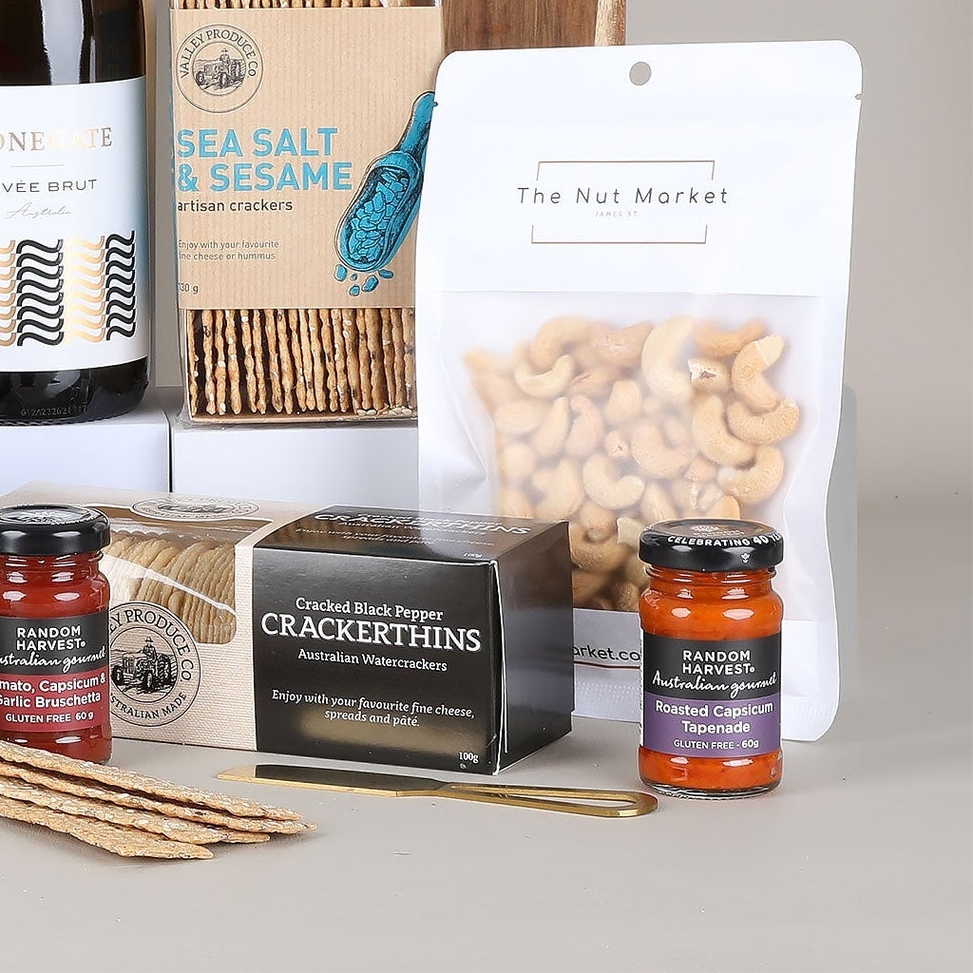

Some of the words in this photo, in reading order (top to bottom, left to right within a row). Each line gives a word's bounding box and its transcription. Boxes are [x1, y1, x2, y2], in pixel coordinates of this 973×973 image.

[179, 33, 206, 79] VALLEY
[205, 28, 257, 60] PRODUCE
[177, 128, 244, 158] SEA
[252, 127, 338, 157] SALT
[48, 179, 98, 192] BRUT
[178, 163, 200, 192] &
[209, 161, 353, 192] SESAME
[517, 186, 561, 204] The
[575, 186, 620, 204] Nut
[634, 186, 728, 204] Market
[177, 199, 225, 212] artisan
[229, 198, 293, 212] crackers
[178, 239, 198, 250] Enjoy
[200, 240, 219, 248] with
[220, 241, 239, 250] your
[242, 240, 279, 249] favourite
[193, 252, 224, 260] cheese
[237, 252, 276, 260] hummus
[667, 535, 751, 547] CELEBRATING
[752, 534, 770, 545] 40
[295, 597, 351, 614] Cracked
[354, 600, 392, 618] Black
[394, 604, 444, 622] Pepper
[17, 626, 82, 639] RANDOM
[124, 608, 190, 656] PRODUCE
[260, 612, 482, 653] CRACKERTHINS
[62, 645, 107, 673] gourmet
[297, 648, 360, 665] Australian
[362, 654, 448, 672] Watercrackers
[572, 644, 641, 661] arket.co
[683, 649, 751, 662] RANDOM
[39, 677, 99, 694] Capsicum
[99, 673, 106, 684] &
[652, 669, 730, 691] Australian
[730, 671, 778, 699] gourmet
[35, 691, 101, 709] Bruschetta
[110, 692, 160, 719] STRALIAN
[161, 692, 188, 717] MADE
[271, 689, 303, 705] Enjoy
[304, 693, 329, 706] with
[330, 697, 357, 709] your
[357, 696, 410, 713] favourite
[410, 702, 434, 714] fine
[435, 704, 476, 719] cheese,
[655, 700, 709, 718] Roasted
[713, 701, 774, 718] Capsicum
[5, 713, 44, 724] GLUTEN
[46, 713, 72, 724] FREE
[324, 710, 367, 724] spreads
[369, 712, 391, 725] and
[392, 713, 420, 728] pâté.
[681, 719, 751, 736] Tapenade
[673, 739, 709, 750] GLUTEN
[711, 739, 735, 750] FREE
[741, 739, 759, 749] 60g
[458, 751, 479, 764] 100g
